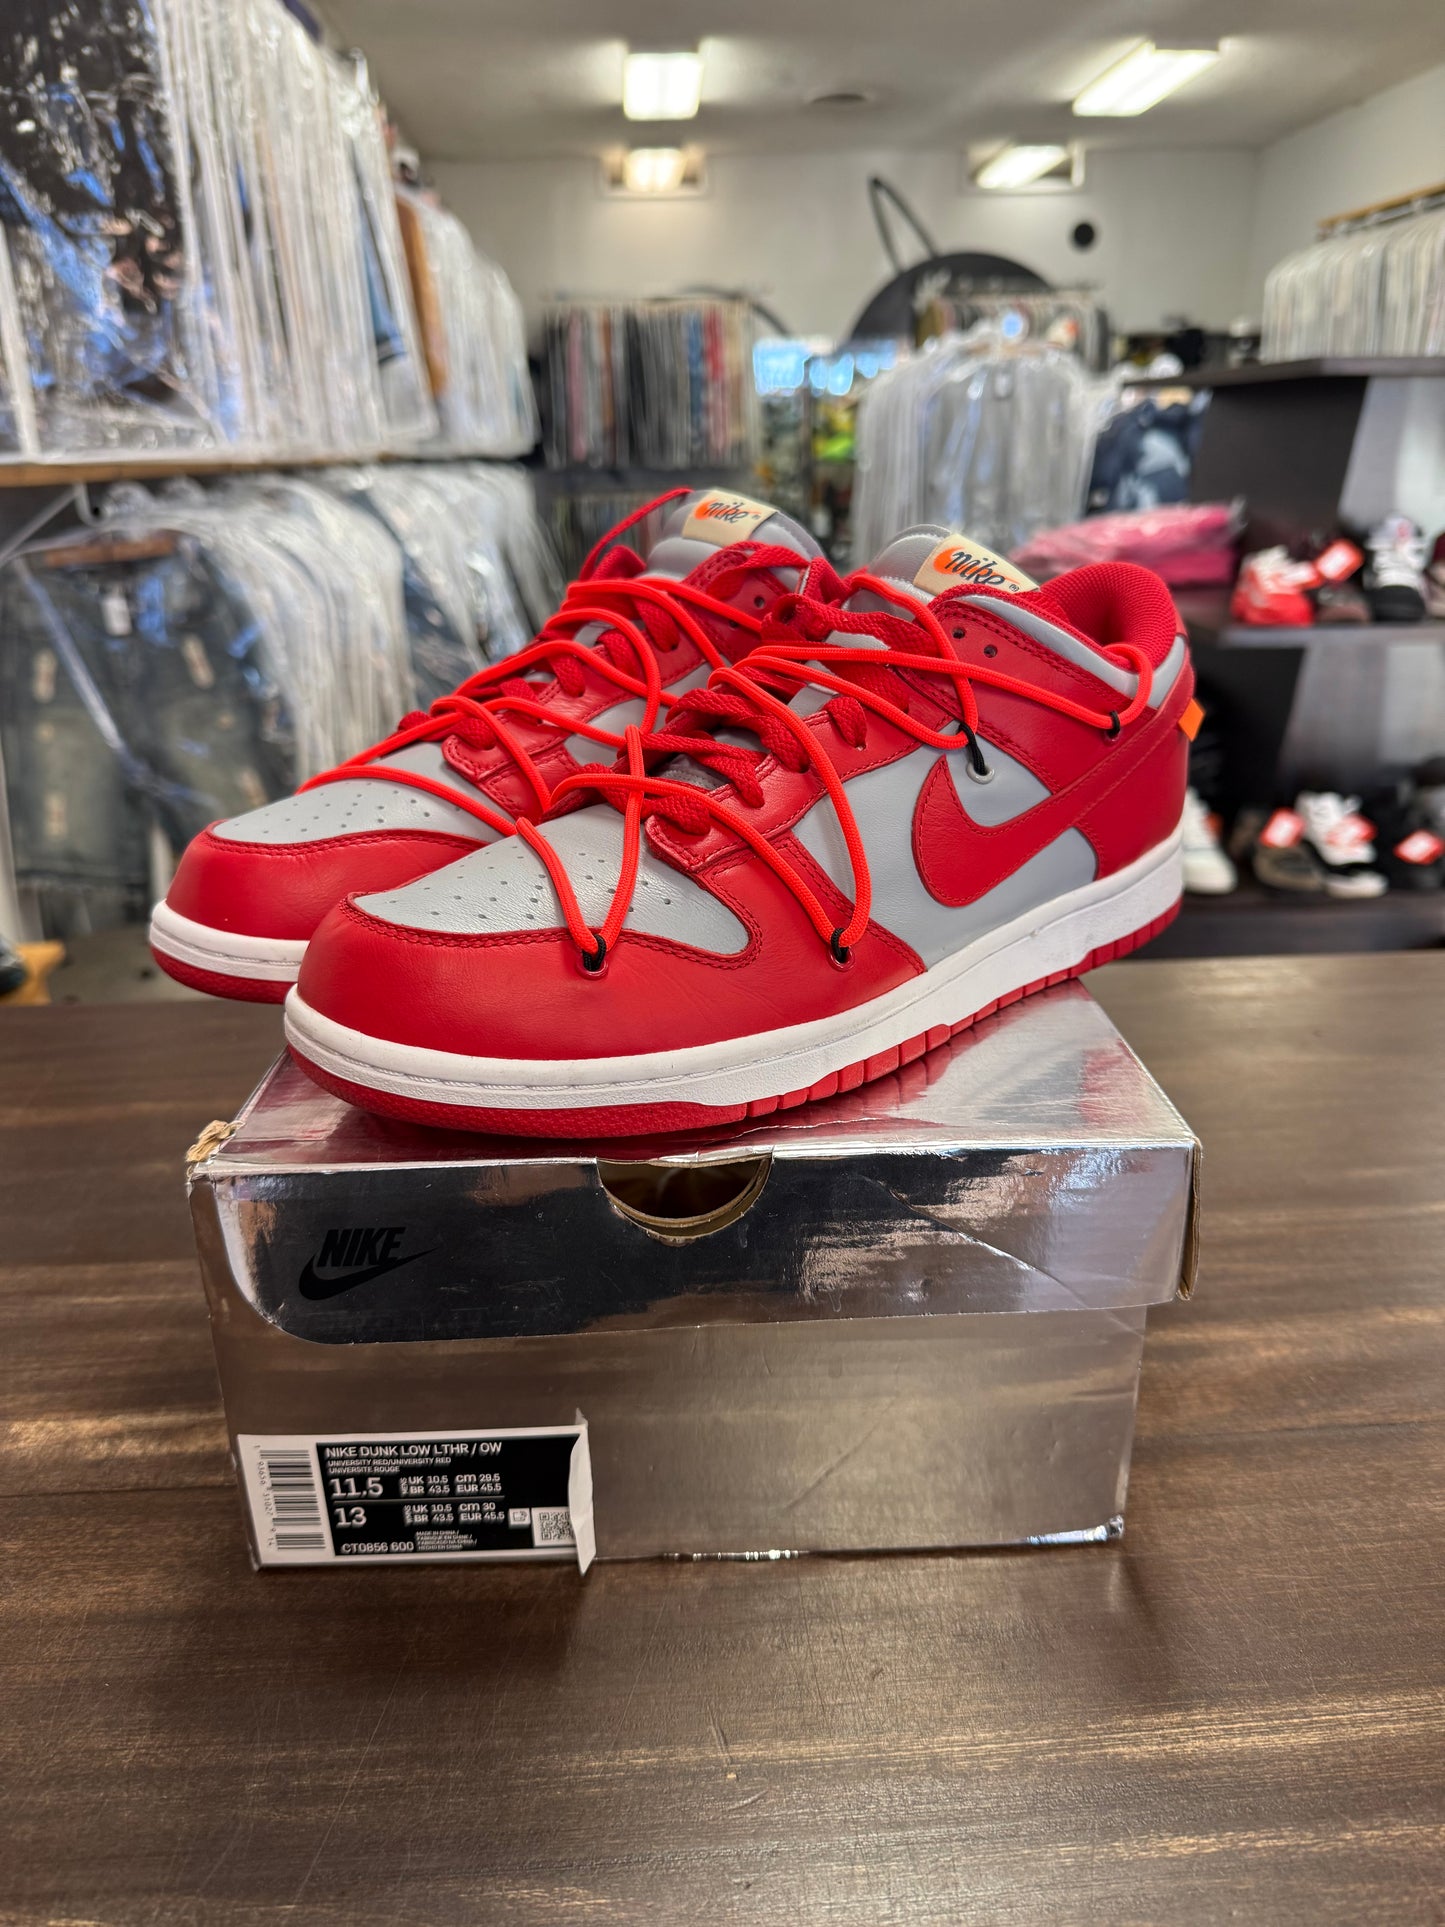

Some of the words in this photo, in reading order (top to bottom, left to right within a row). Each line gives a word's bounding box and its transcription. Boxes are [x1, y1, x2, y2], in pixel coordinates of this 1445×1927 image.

[316, 1226, 406, 1268] NIKE
[326, 1446, 357, 1458] NIKE
[360, 1445, 398, 1457] DUNK
[401, 1444, 431, 1456] LOW
[434, 1443, 469, 1455] LTHR
[480, 1442, 502, 1453] OW
[409, 1476, 424, 1485] UK
[427, 1475, 448, 1484] 10.5
[456, 1474, 476, 1483] cm
[480, 1473, 500, 1482] 29.5
[330, 1477, 383, 1496] 11.5
[410, 1486, 424, 1494] BR
[428, 1485, 450, 1493] 43.5
[457, 1484, 478, 1493] EUR
[480, 1483, 501, 1492] 45.5
[412, 1504, 428, 1513] UK
[431, 1503, 452, 1512] 10.5
[460, 1502, 480, 1511] cm
[483, 1502, 496, 1510] 30
[335, 1507, 367, 1526] 13
[414, 1514, 428, 1522] BR
[432, 1513, 454, 1521] 43.5
[461, 1513, 481, 1521] EUR
[483, 1511, 505, 1520] 45.5
[391, 1541, 414, 1551] 600
